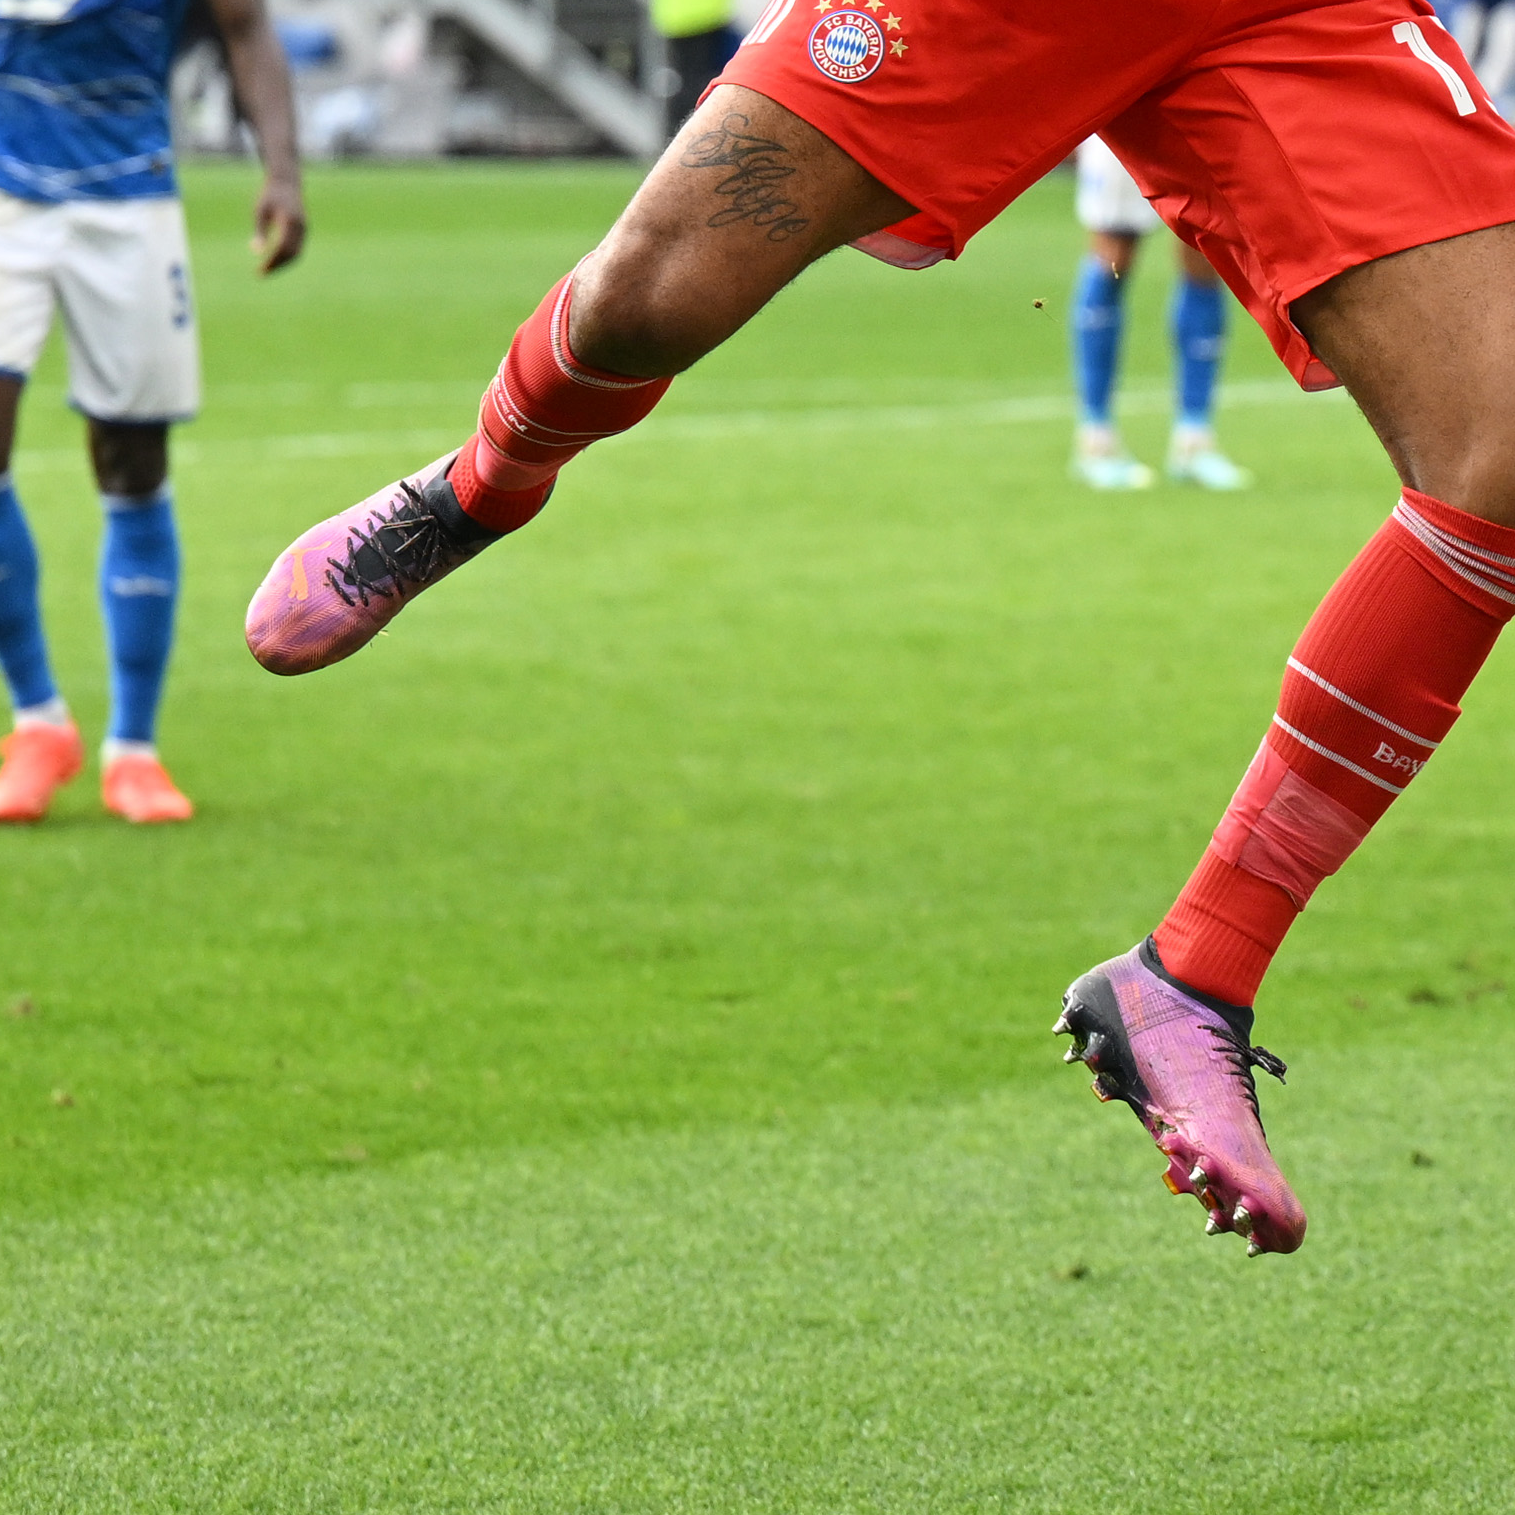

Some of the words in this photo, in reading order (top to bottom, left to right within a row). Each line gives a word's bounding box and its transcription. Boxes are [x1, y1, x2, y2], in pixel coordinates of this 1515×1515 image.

[824, 16, 842, 30] FC
[845, 14, 880, 57] BAYERN
[813, 38, 868, 78] MÜNCHEN
